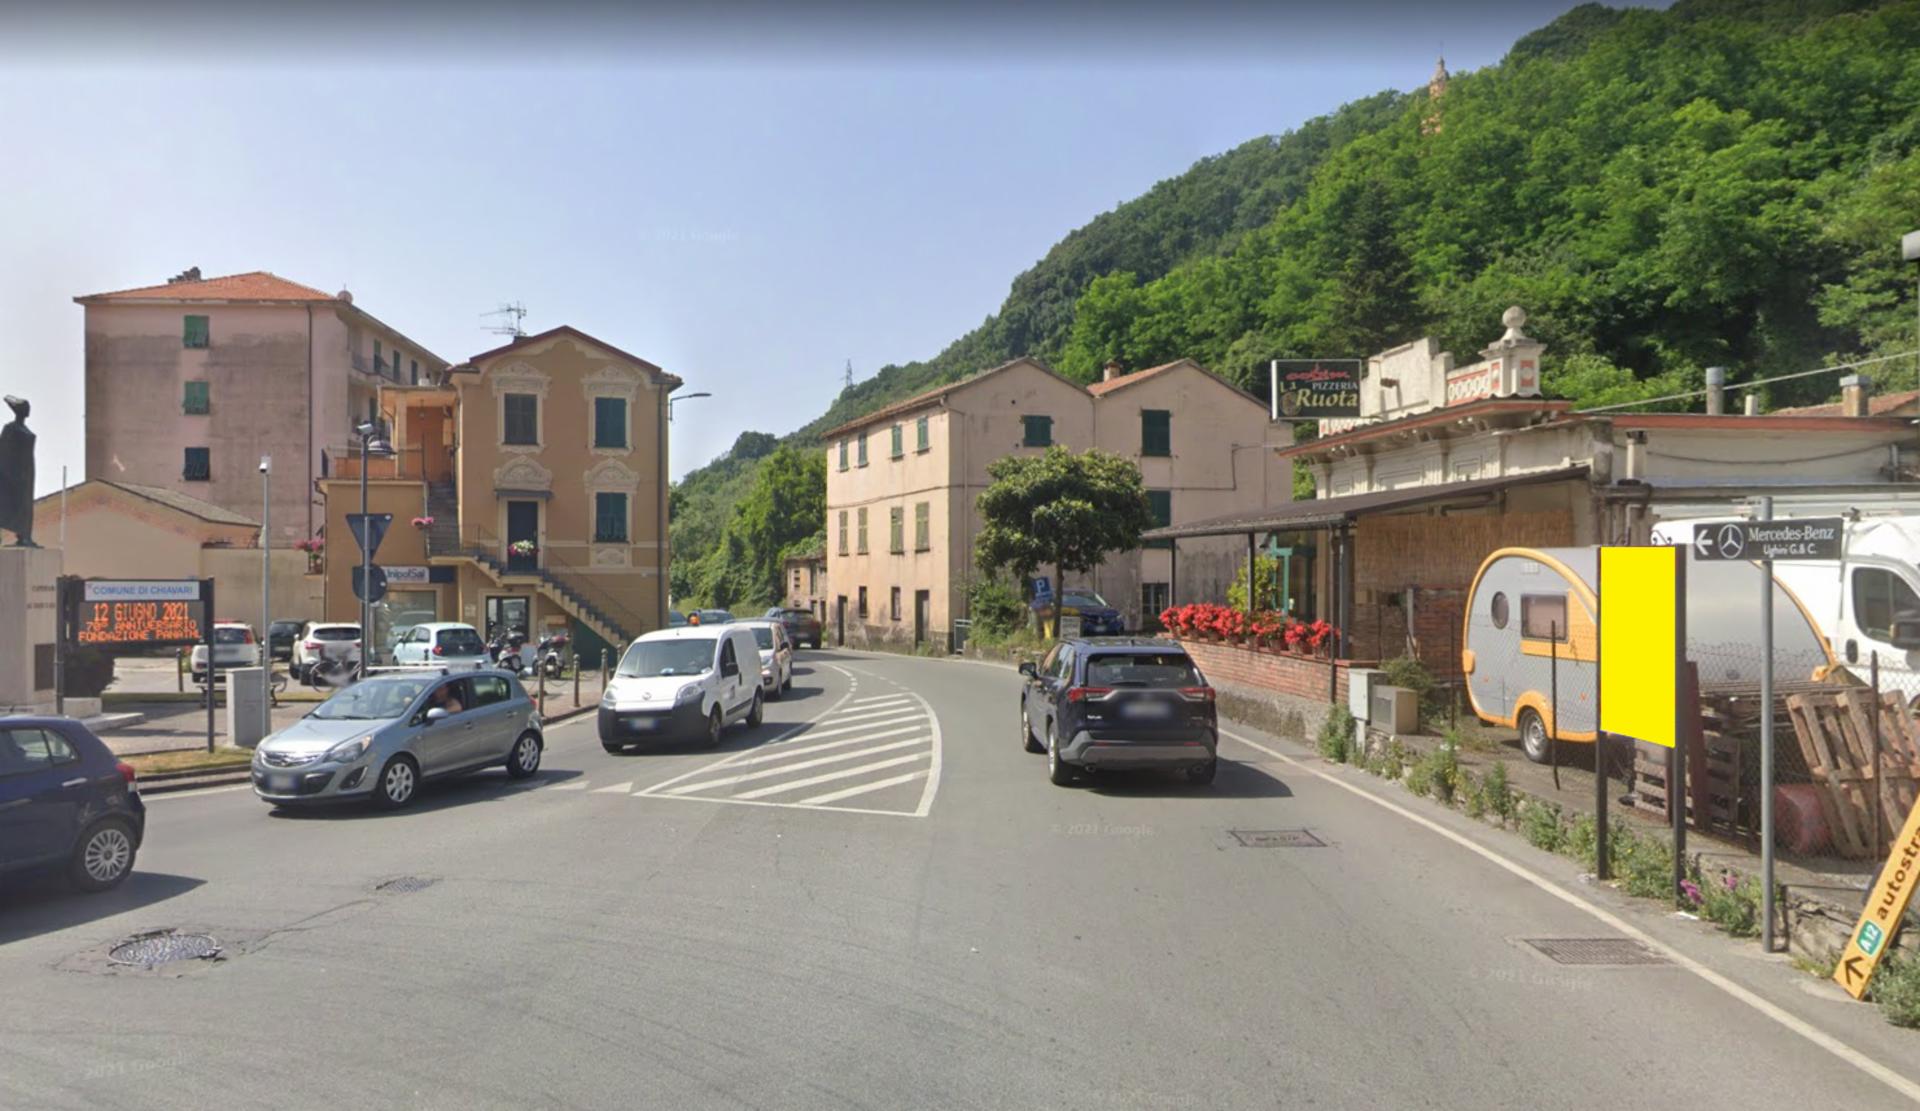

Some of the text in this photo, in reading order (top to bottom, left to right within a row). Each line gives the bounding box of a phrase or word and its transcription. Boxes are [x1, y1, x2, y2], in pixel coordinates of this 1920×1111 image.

[1312, 381, 1358, 390] PIZZERIA
[1296, 388, 1358, 408] Ruota
[1749, 525, 1834, 541] Mercedes-Benz
[93, 585, 193, 595] COMUNE DI CHIAVARI
[94, 602, 189, 621] 12 GIUGNO 2021
[115, 619, 197, 631] ANNIVERSARIO
[78, 631, 150, 642] FONDAZIONE
